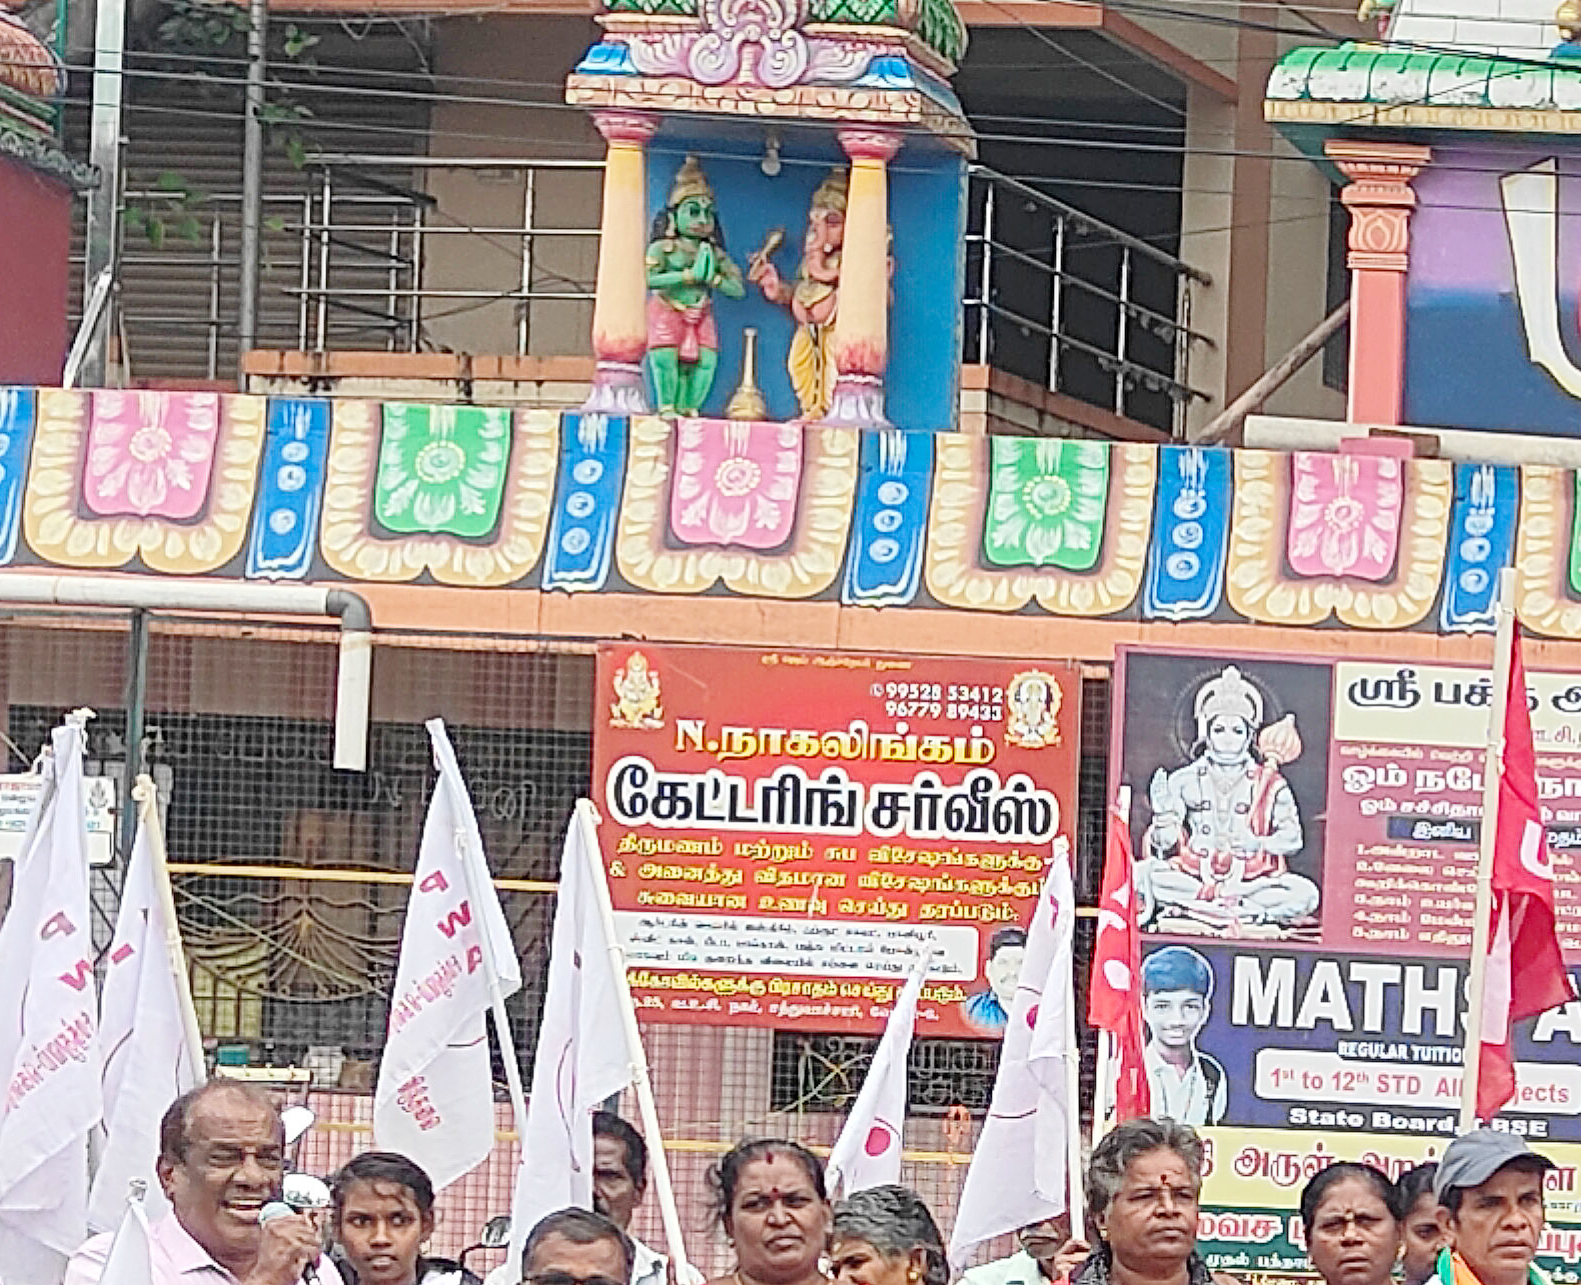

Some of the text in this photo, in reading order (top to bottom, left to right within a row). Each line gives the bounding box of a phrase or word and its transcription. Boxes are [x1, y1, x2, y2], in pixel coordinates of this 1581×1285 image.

[886, 683, 1004, 704] 99528 53412
[885, 701, 942, 719] 96779
[675, 719, 996, 764] N.நாகலிங்கம்
[613, 763, 1054, 836] கேட்டரிங் சர்வீஸ்
[734, 839, 813, 863] மற்றும்
[609, 862, 627, 879] &
[1232, 955, 1470, 1037] MATH
[1337, 1040, 1465, 1063] REGULAR TUITIO
[1302, 1070, 1323, 1089] to
[1331, 1070, 1370, 1092] 12th
[1377, 1075, 1420, 1096] STD
